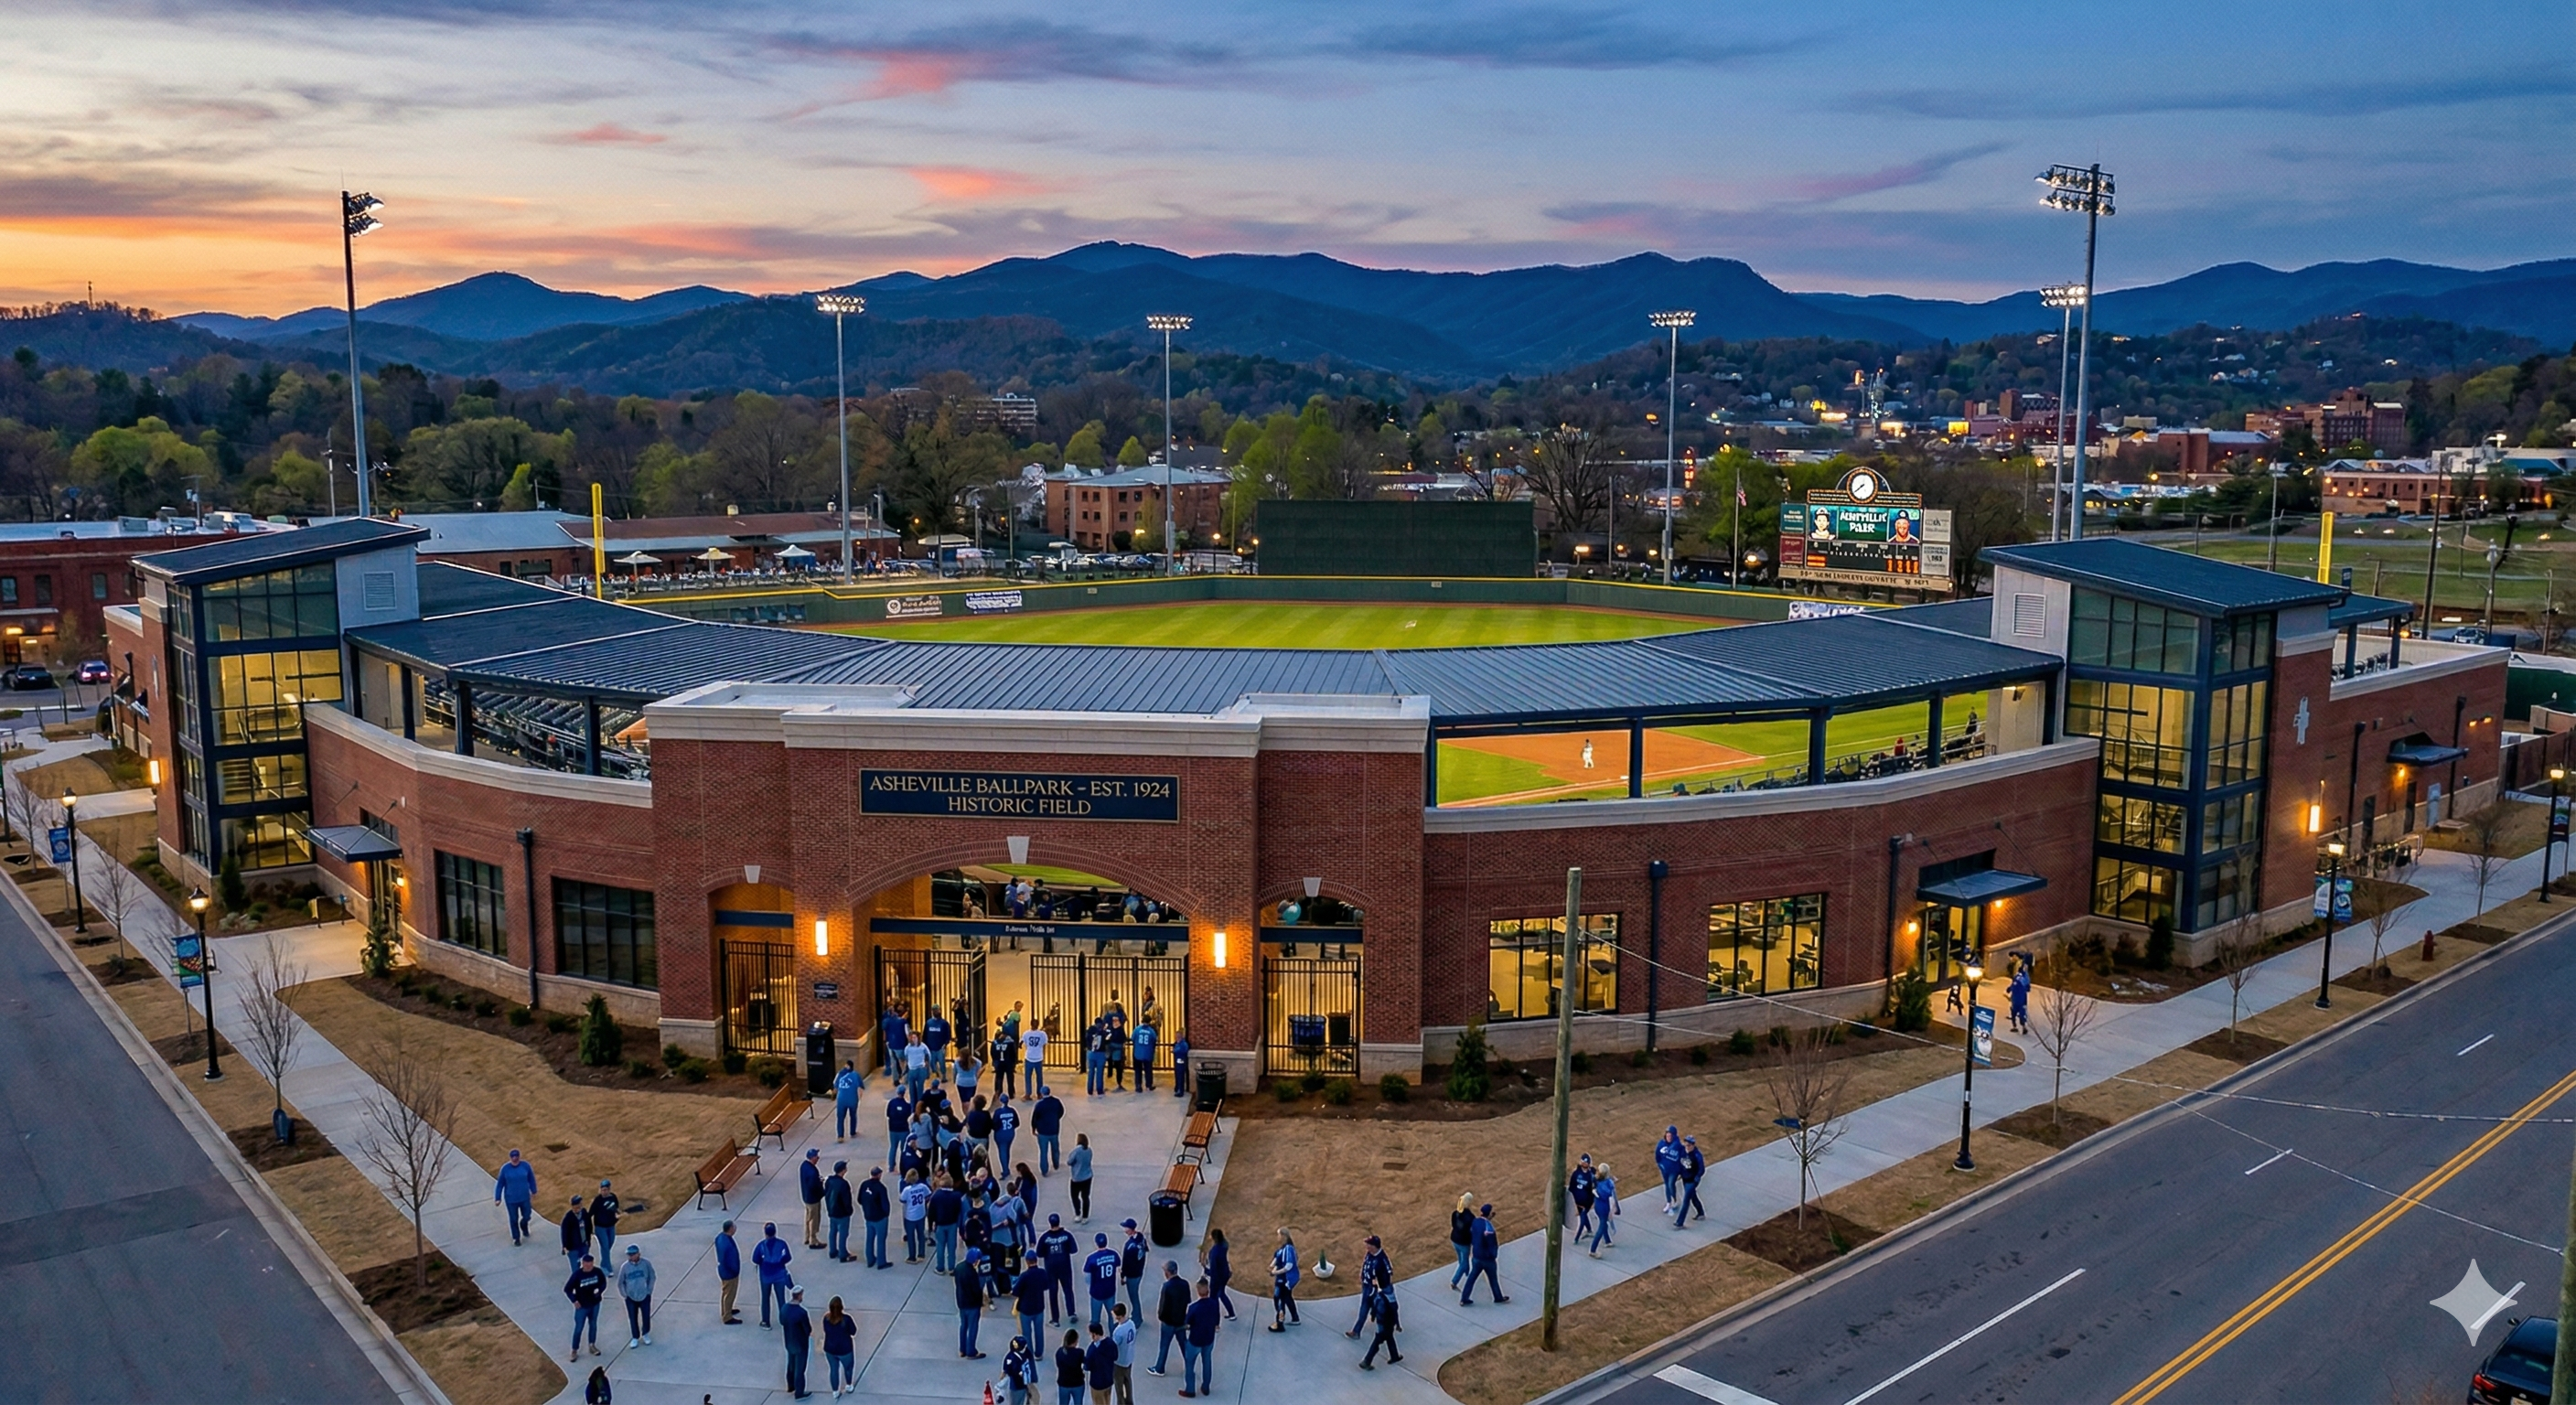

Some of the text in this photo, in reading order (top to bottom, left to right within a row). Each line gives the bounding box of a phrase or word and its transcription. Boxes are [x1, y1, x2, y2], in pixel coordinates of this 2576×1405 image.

[869, 775, 972, 793] ASHEVILLE
[976, 778, 1075, 796] BALLPARK
[1090, 780, 1127, 797] EST.
[1133, 782, 1170, 798] 1924
[948, 796, 1091, 815] HISTORIC FIELD
[1100, 1264, 1113, 1279] 18
